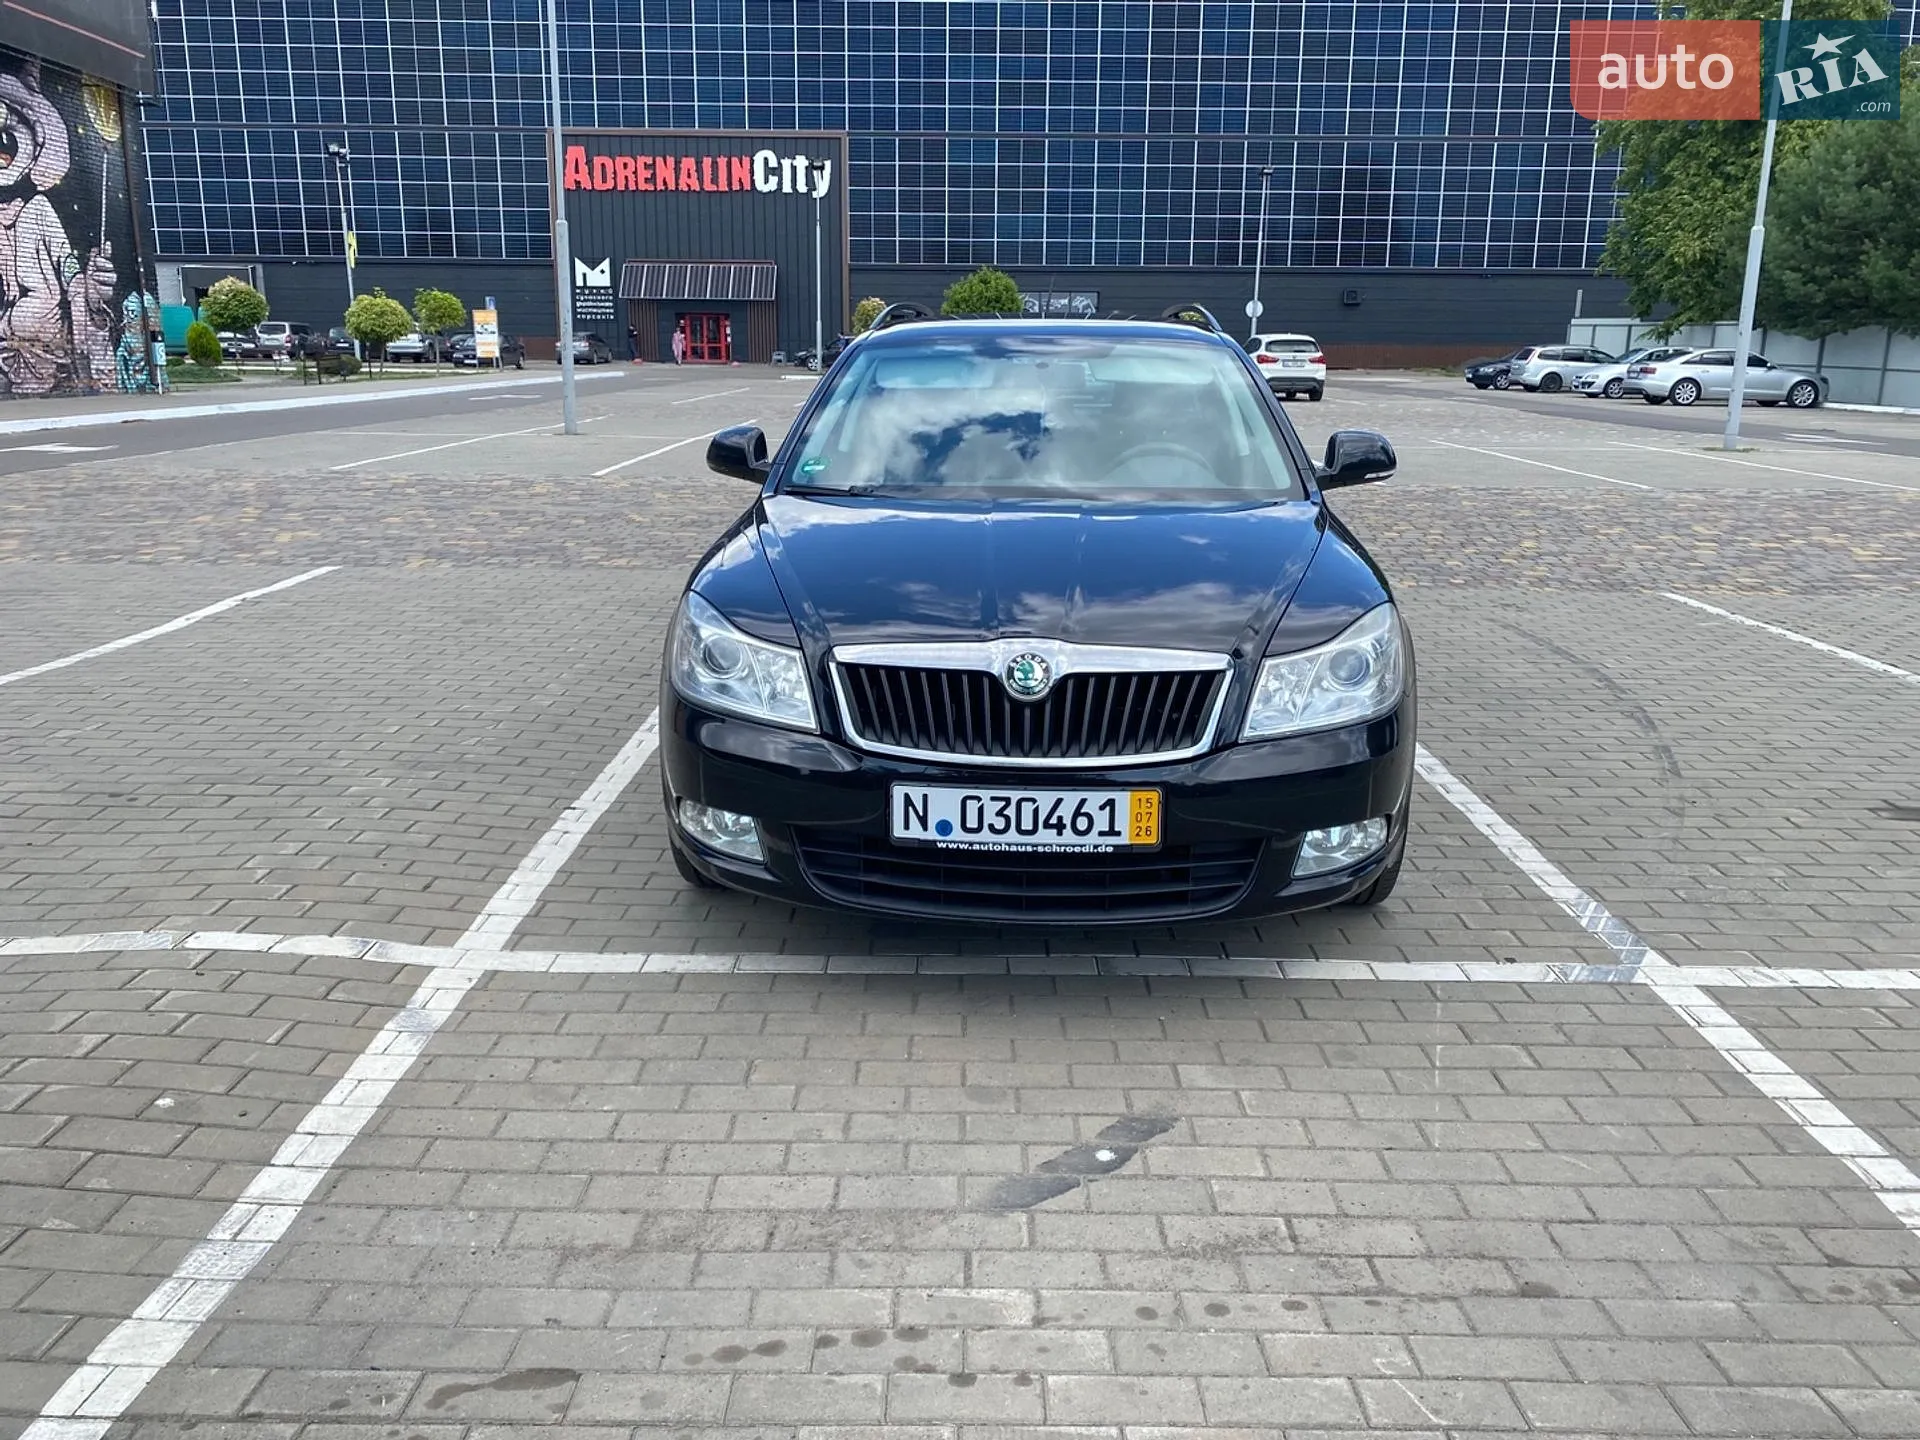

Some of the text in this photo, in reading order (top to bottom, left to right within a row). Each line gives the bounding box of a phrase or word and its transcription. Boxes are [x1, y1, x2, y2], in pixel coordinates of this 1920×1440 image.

[1137, 797, 1153, 809] 15
[903, 792, 1122, 837] N 030461
[1135, 811, 1152, 823] 07
[1135, 825, 1152, 837] 26
[936, 841, 1114, 853] www.autohaus-schroedl.de
